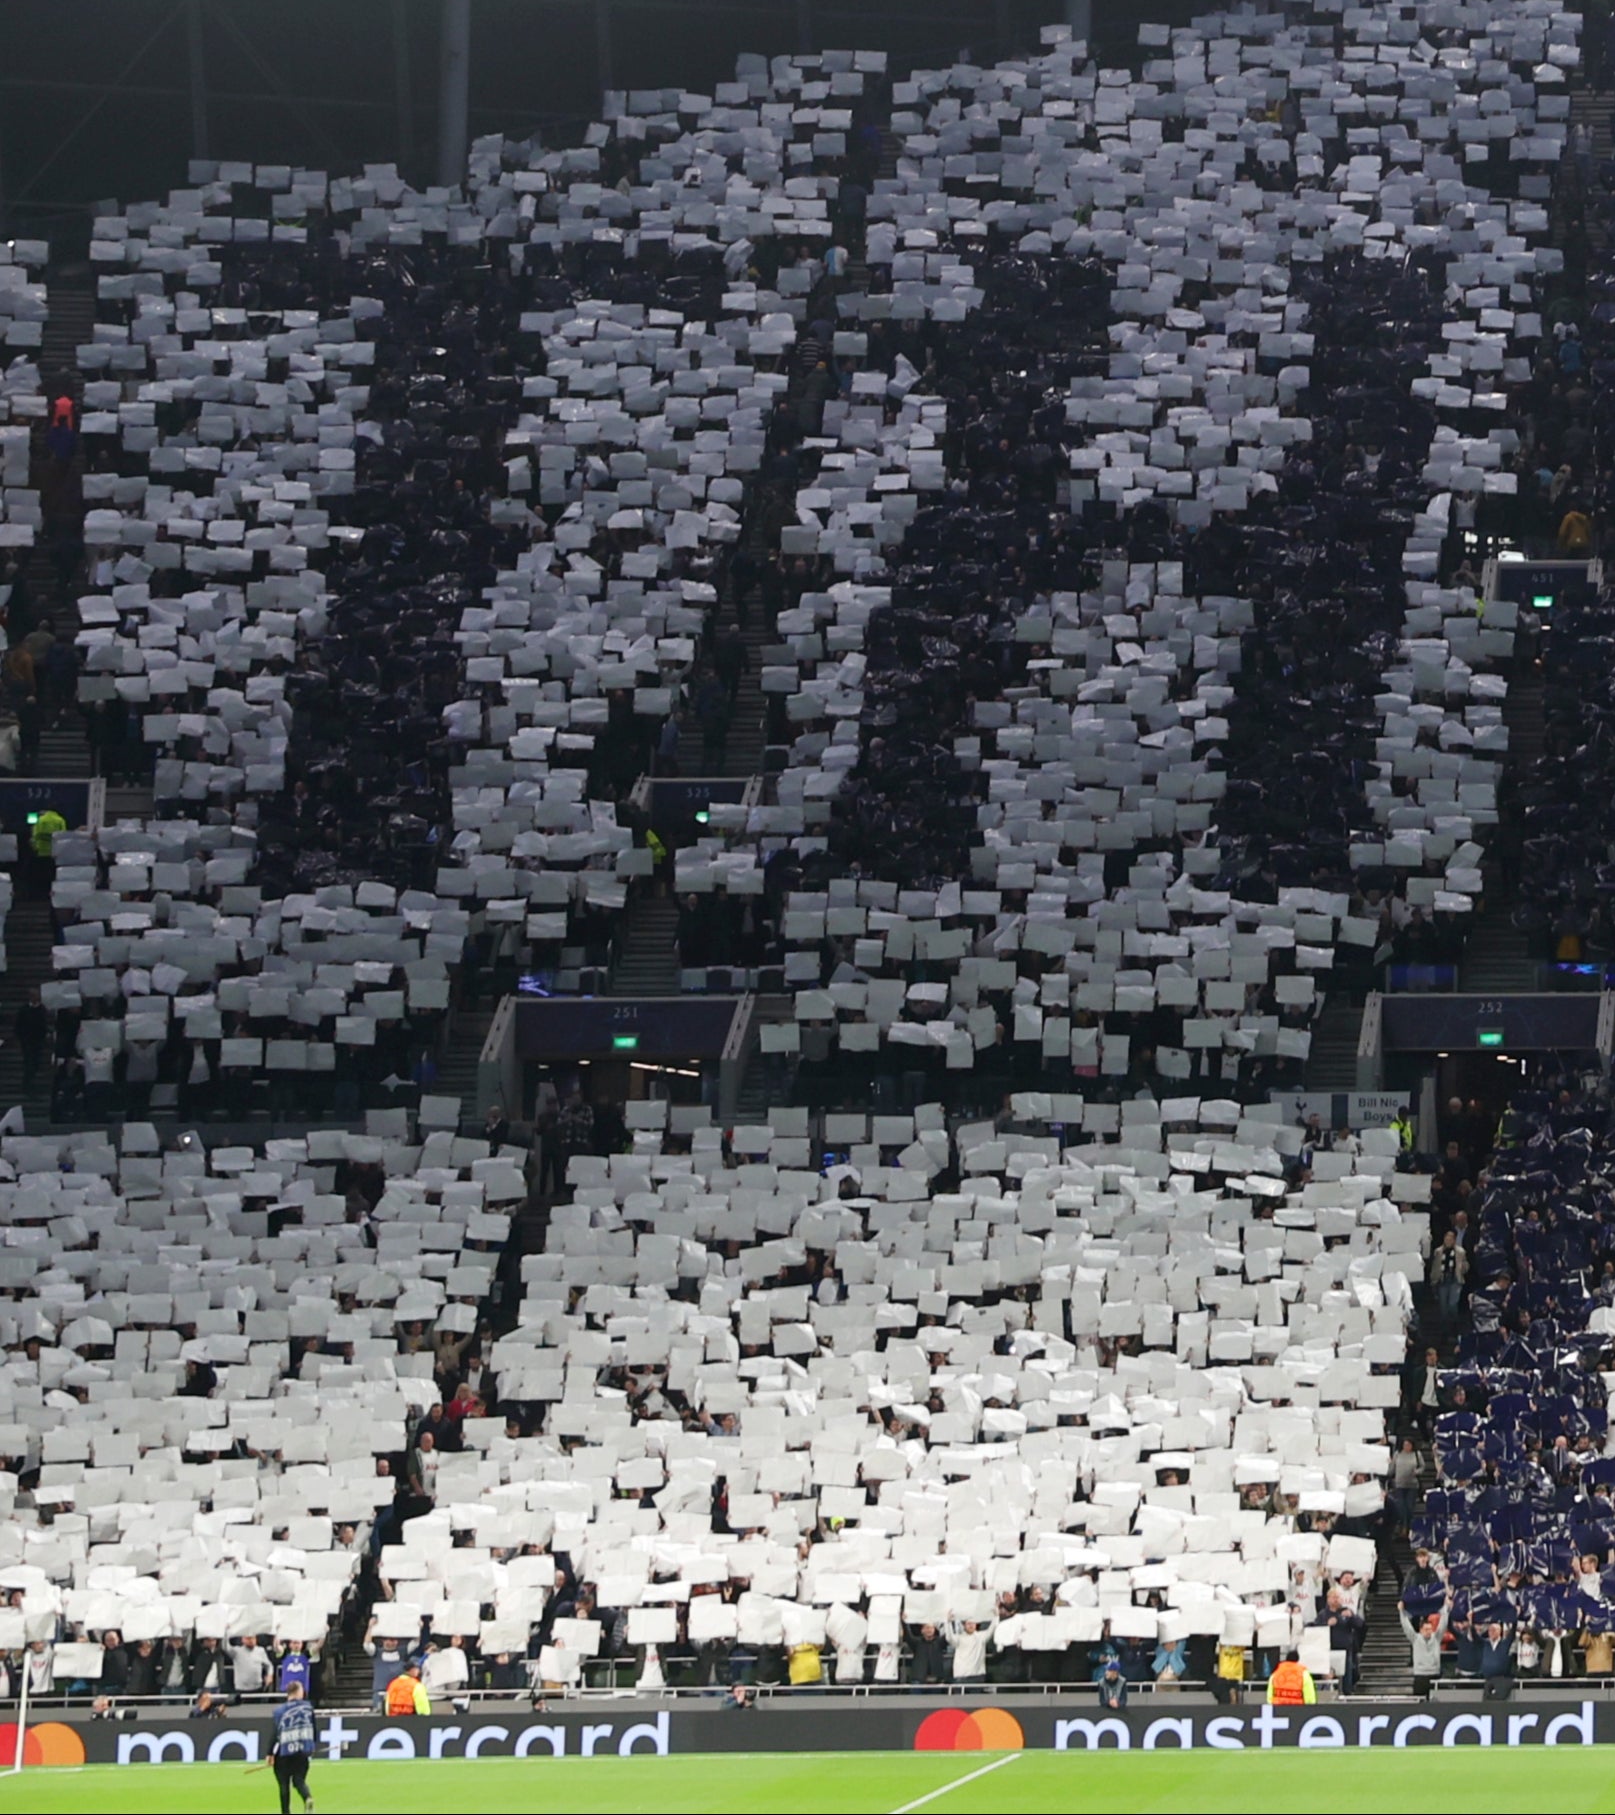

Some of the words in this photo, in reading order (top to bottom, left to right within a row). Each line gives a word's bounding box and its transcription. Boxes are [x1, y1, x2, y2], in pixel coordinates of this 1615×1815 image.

[613, 1006, 638, 1019] 251
[1478, 1001, 1503, 1014] 252
[118, 1712, 669, 1764] matercard
[1055, 1702, 1594, 1750] mastercard
